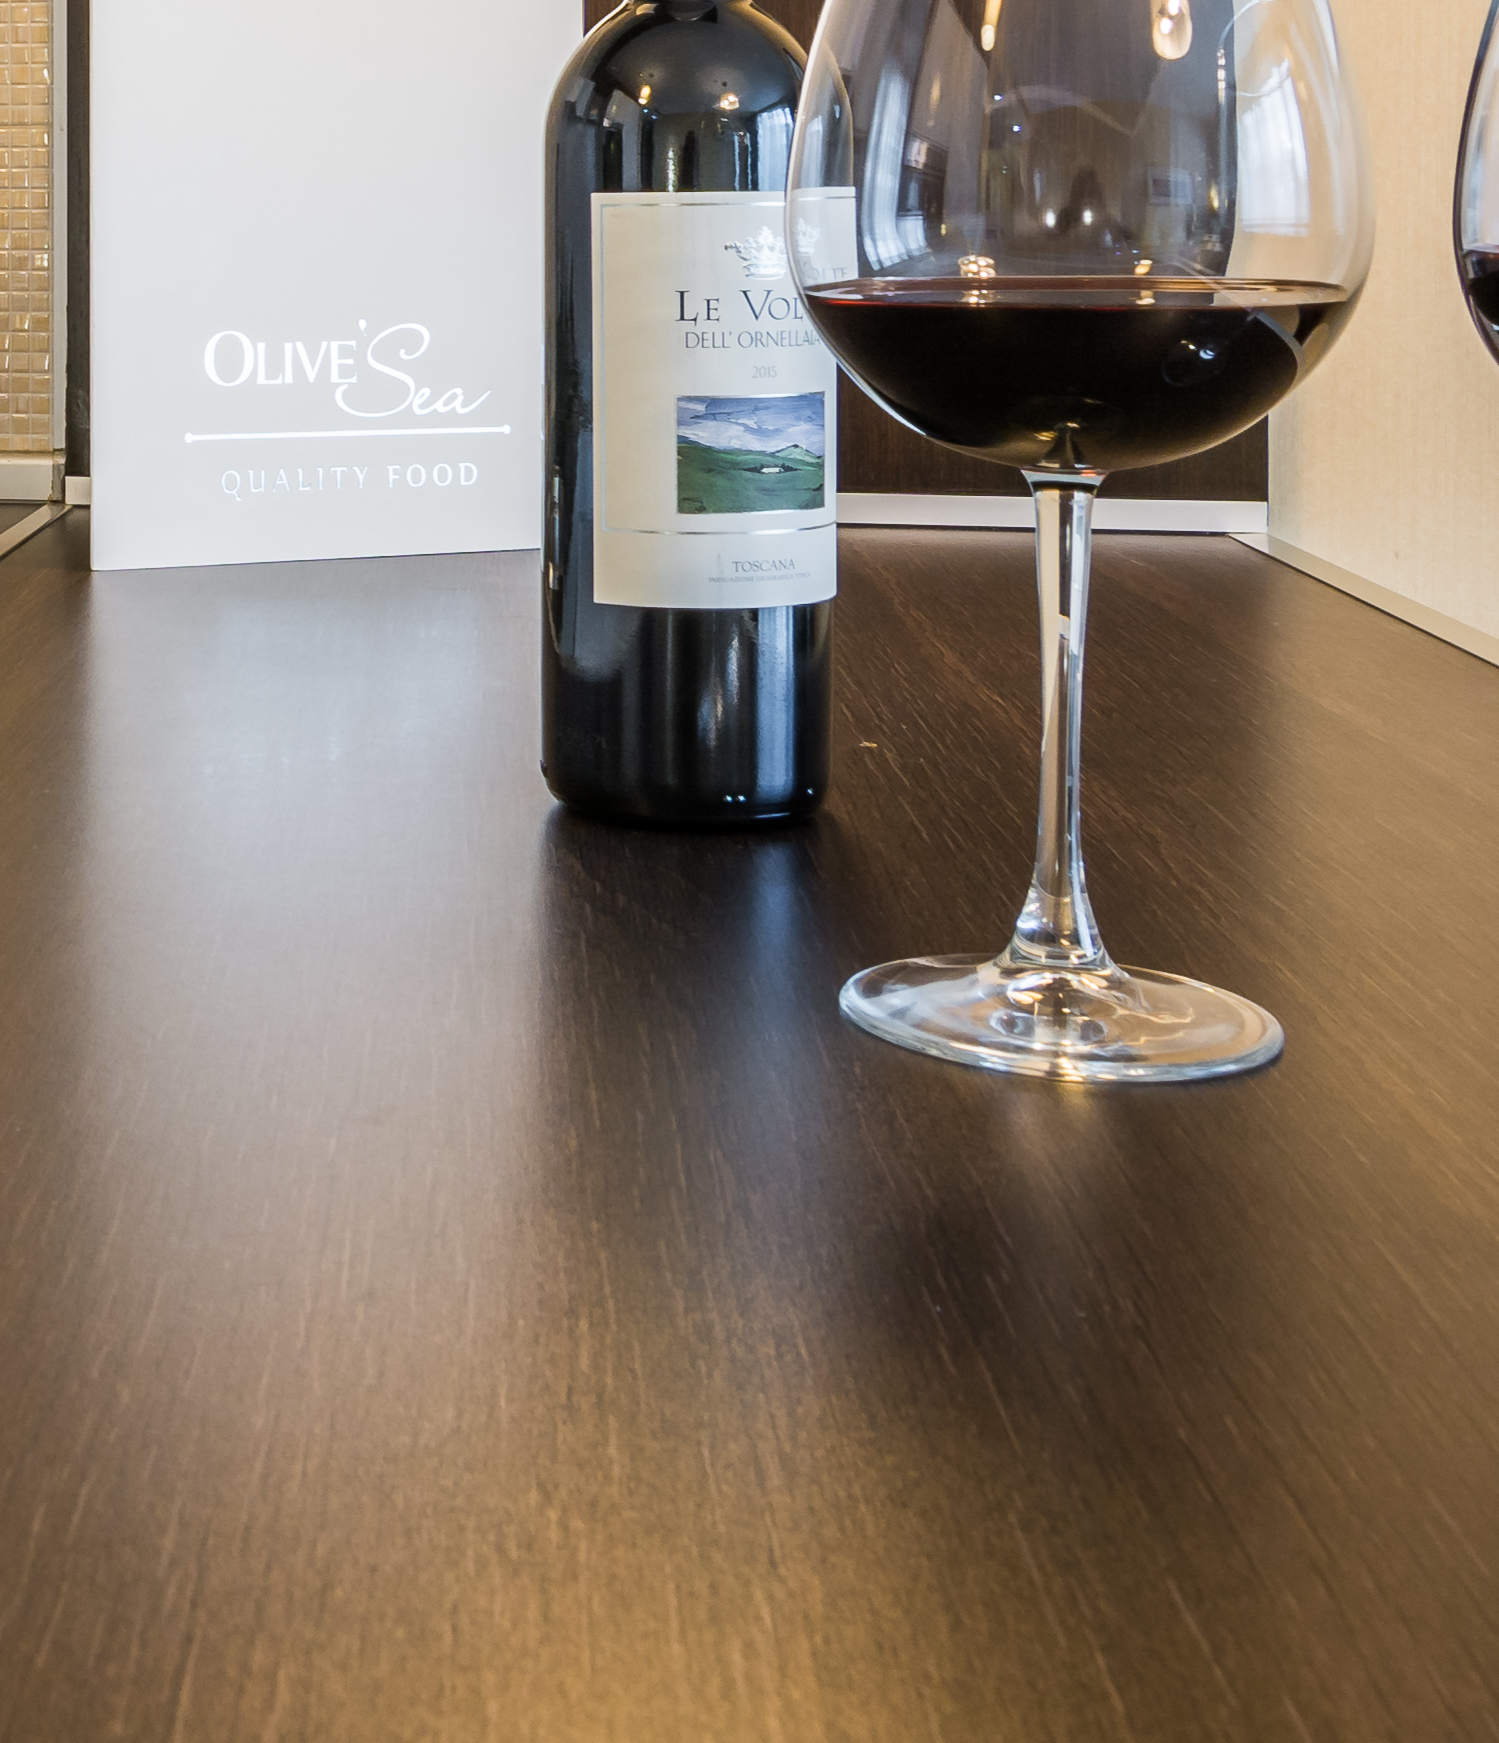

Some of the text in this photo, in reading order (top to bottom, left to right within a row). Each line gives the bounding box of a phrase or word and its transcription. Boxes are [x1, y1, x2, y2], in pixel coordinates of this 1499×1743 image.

[334, 322, 492, 418] Sea
[751, 365, 778, 379] 2015
[220, 461, 479, 502] QUALITY FOOD
[731, 559, 796, 572] TOSCANA
